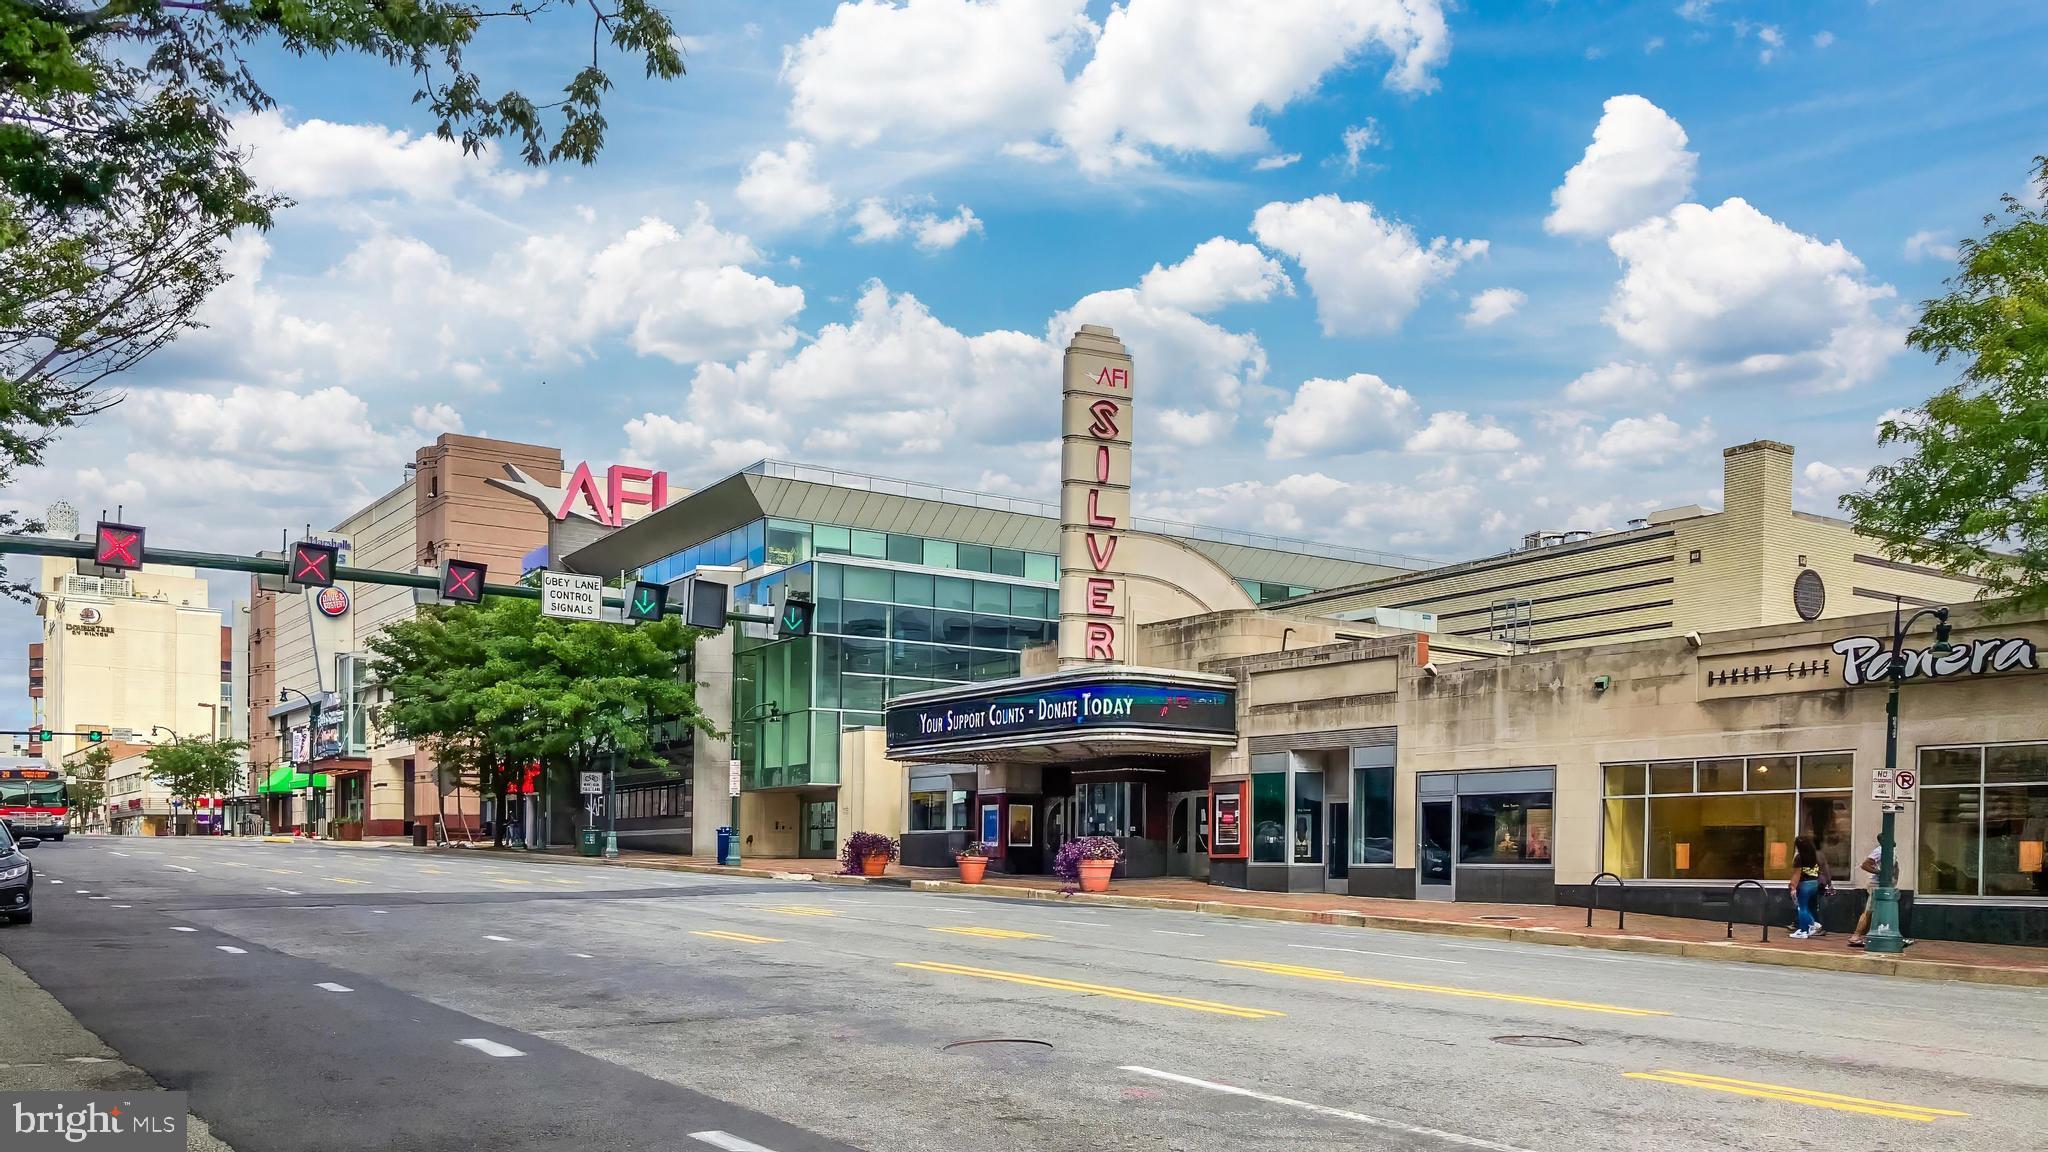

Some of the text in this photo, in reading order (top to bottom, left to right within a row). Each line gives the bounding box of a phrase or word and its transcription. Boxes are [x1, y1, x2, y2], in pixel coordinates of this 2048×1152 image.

[1098, 366, 1128, 389] AFI
[556, 460, 667, 528] AFI
[1086, 400, 1120, 661] SILVER
[545, 576, 600, 590] OBEY LANE
[550, 590, 594, 603] CONTROL
[551, 602, 593, 615] SIGNALS
[1832, 635, 2038, 685] Panera
[1708, 659, 1830, 687] BAKERY CAFE
[920, 712, 943, 734] YOUR
[947, 710, 986, 731] SUPPORT
[989, 704, 1025, 726] COUNTS
[1038, 698, 1078, 720] DONATE
[1082, 692, 1134, 717] TODAY
[1877, 770, 1888, 778] NO
